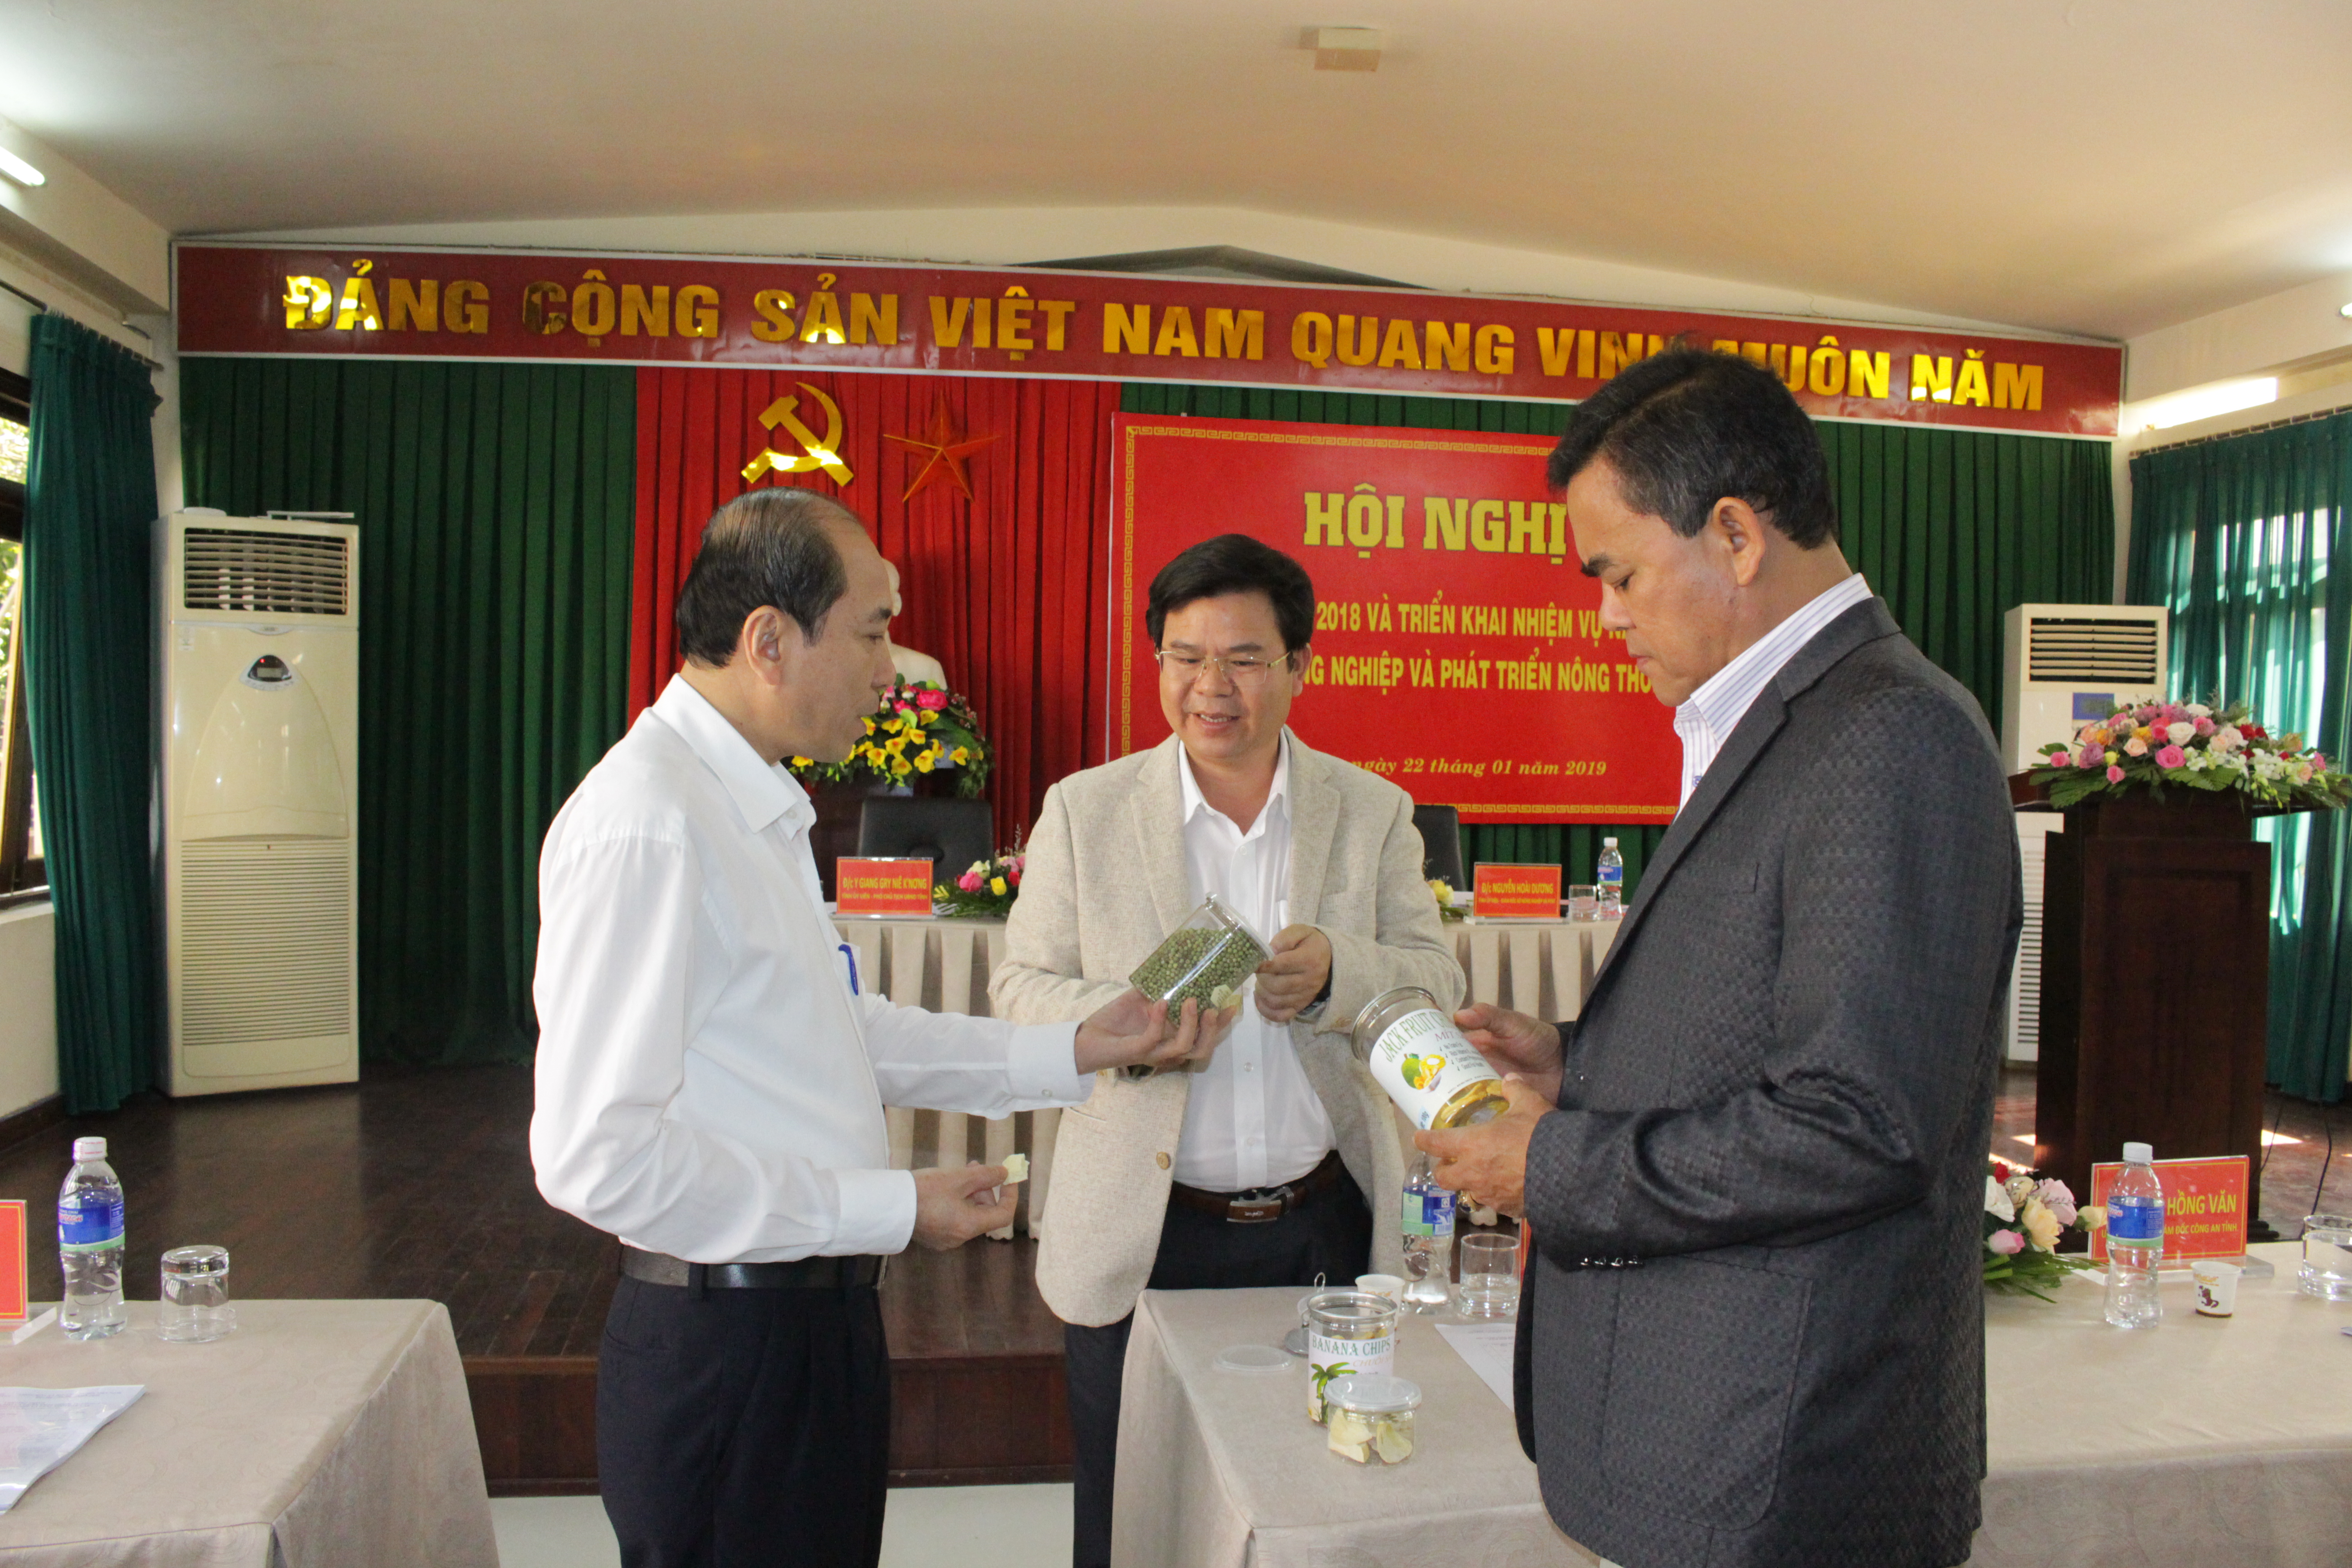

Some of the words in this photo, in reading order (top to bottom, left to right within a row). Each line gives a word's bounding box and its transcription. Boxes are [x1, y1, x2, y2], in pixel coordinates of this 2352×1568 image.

[283, 259, 489, 333] ĐẢNG
[522, 269, 720, 347] CỘNG
[750, 273, 897, 345] SẢN
[928, 286, 1075, 360] VIỆT
[1103, 303, 1264, 360] NAM
[1291, 311, 1514, 374] QUANG
[1911, 348, 2043, 411] NĂM
[1303, 483, 1405, 559] HỘI
[1422, 495, 1567, 564] NGHỊ
[1317, 601, 1361, 631] 2018
[1367, 593, 1392, 632] VÀ
[1398, 590, 1455, 634] TRIỂN
[1461, 605, 1506, 635] KHAI
[1513, 602, 1573, 646] NHIỆM
[1578, 610, 1602, 647] VỤ
[1331, 650, 1404, 695] NGHIỆP
[1409, 649, 1434, 687] VÀ
[1441, 650, 1490, 689] PHÁT
[1496, 647, 1552, 691] TRIỂN
[1558, 656, 1610, 692] NÔNG
[1402, 758, 1425, 773] 22
[1430, 758, 1486, 777] tháng
[1492, 760, 1511, 774] 01
[1519, 760, 1559, 775] năm
[1565, 760, 1607, 776] 2019
[859, 877, 878, 888] GIANG
[1379, 1027, 1409, 1062] JACK
[1399, 1012, 1436, 1039] FRUIT
[2167, 1189, 2205, 1215] HỒNG
[2209, 1189, 2236, 1214] VĂN
[2175, 1222, 2189, 1234] ĐỐC
[2190, 1223, 2209, 1234] CÔNG
[2210, 1224, 2220, 1232] AN
[2223, 1221, 2237, 1232] TỈNH
[1313, 1335, 1359, 1356] BANANA
[1363, 1338, 1391, 1356] CHIPS
